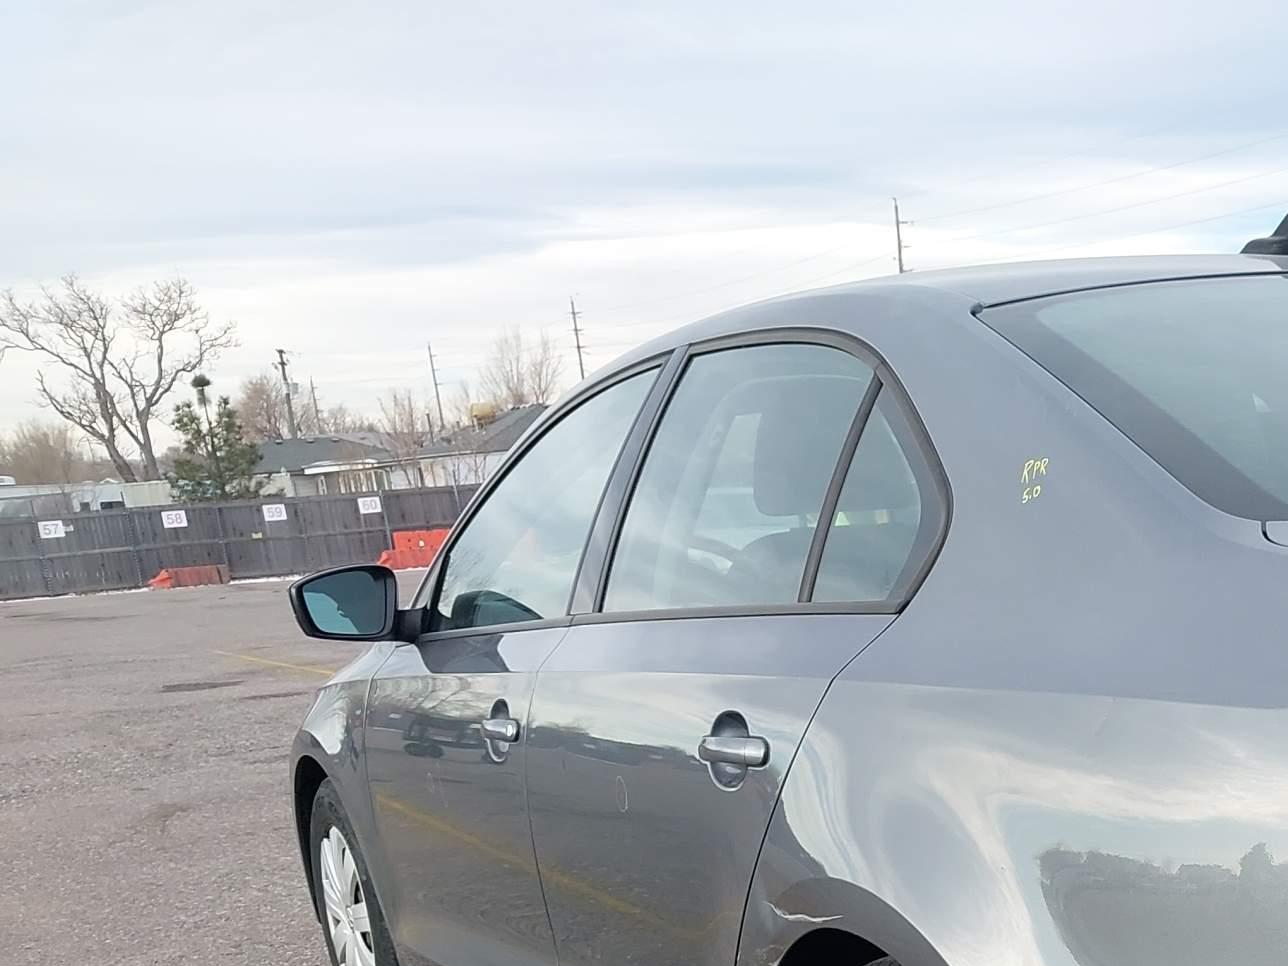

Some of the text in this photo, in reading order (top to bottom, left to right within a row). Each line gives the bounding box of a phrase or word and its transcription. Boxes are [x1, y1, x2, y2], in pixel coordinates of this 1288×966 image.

[1020, 457, 1049, 483] RPR
[362, 498, 378, 511] 60
[165, 512, 183, 525] 58
[266, 506, 284, 519] 59
[42, 524, 59, 535] 57
